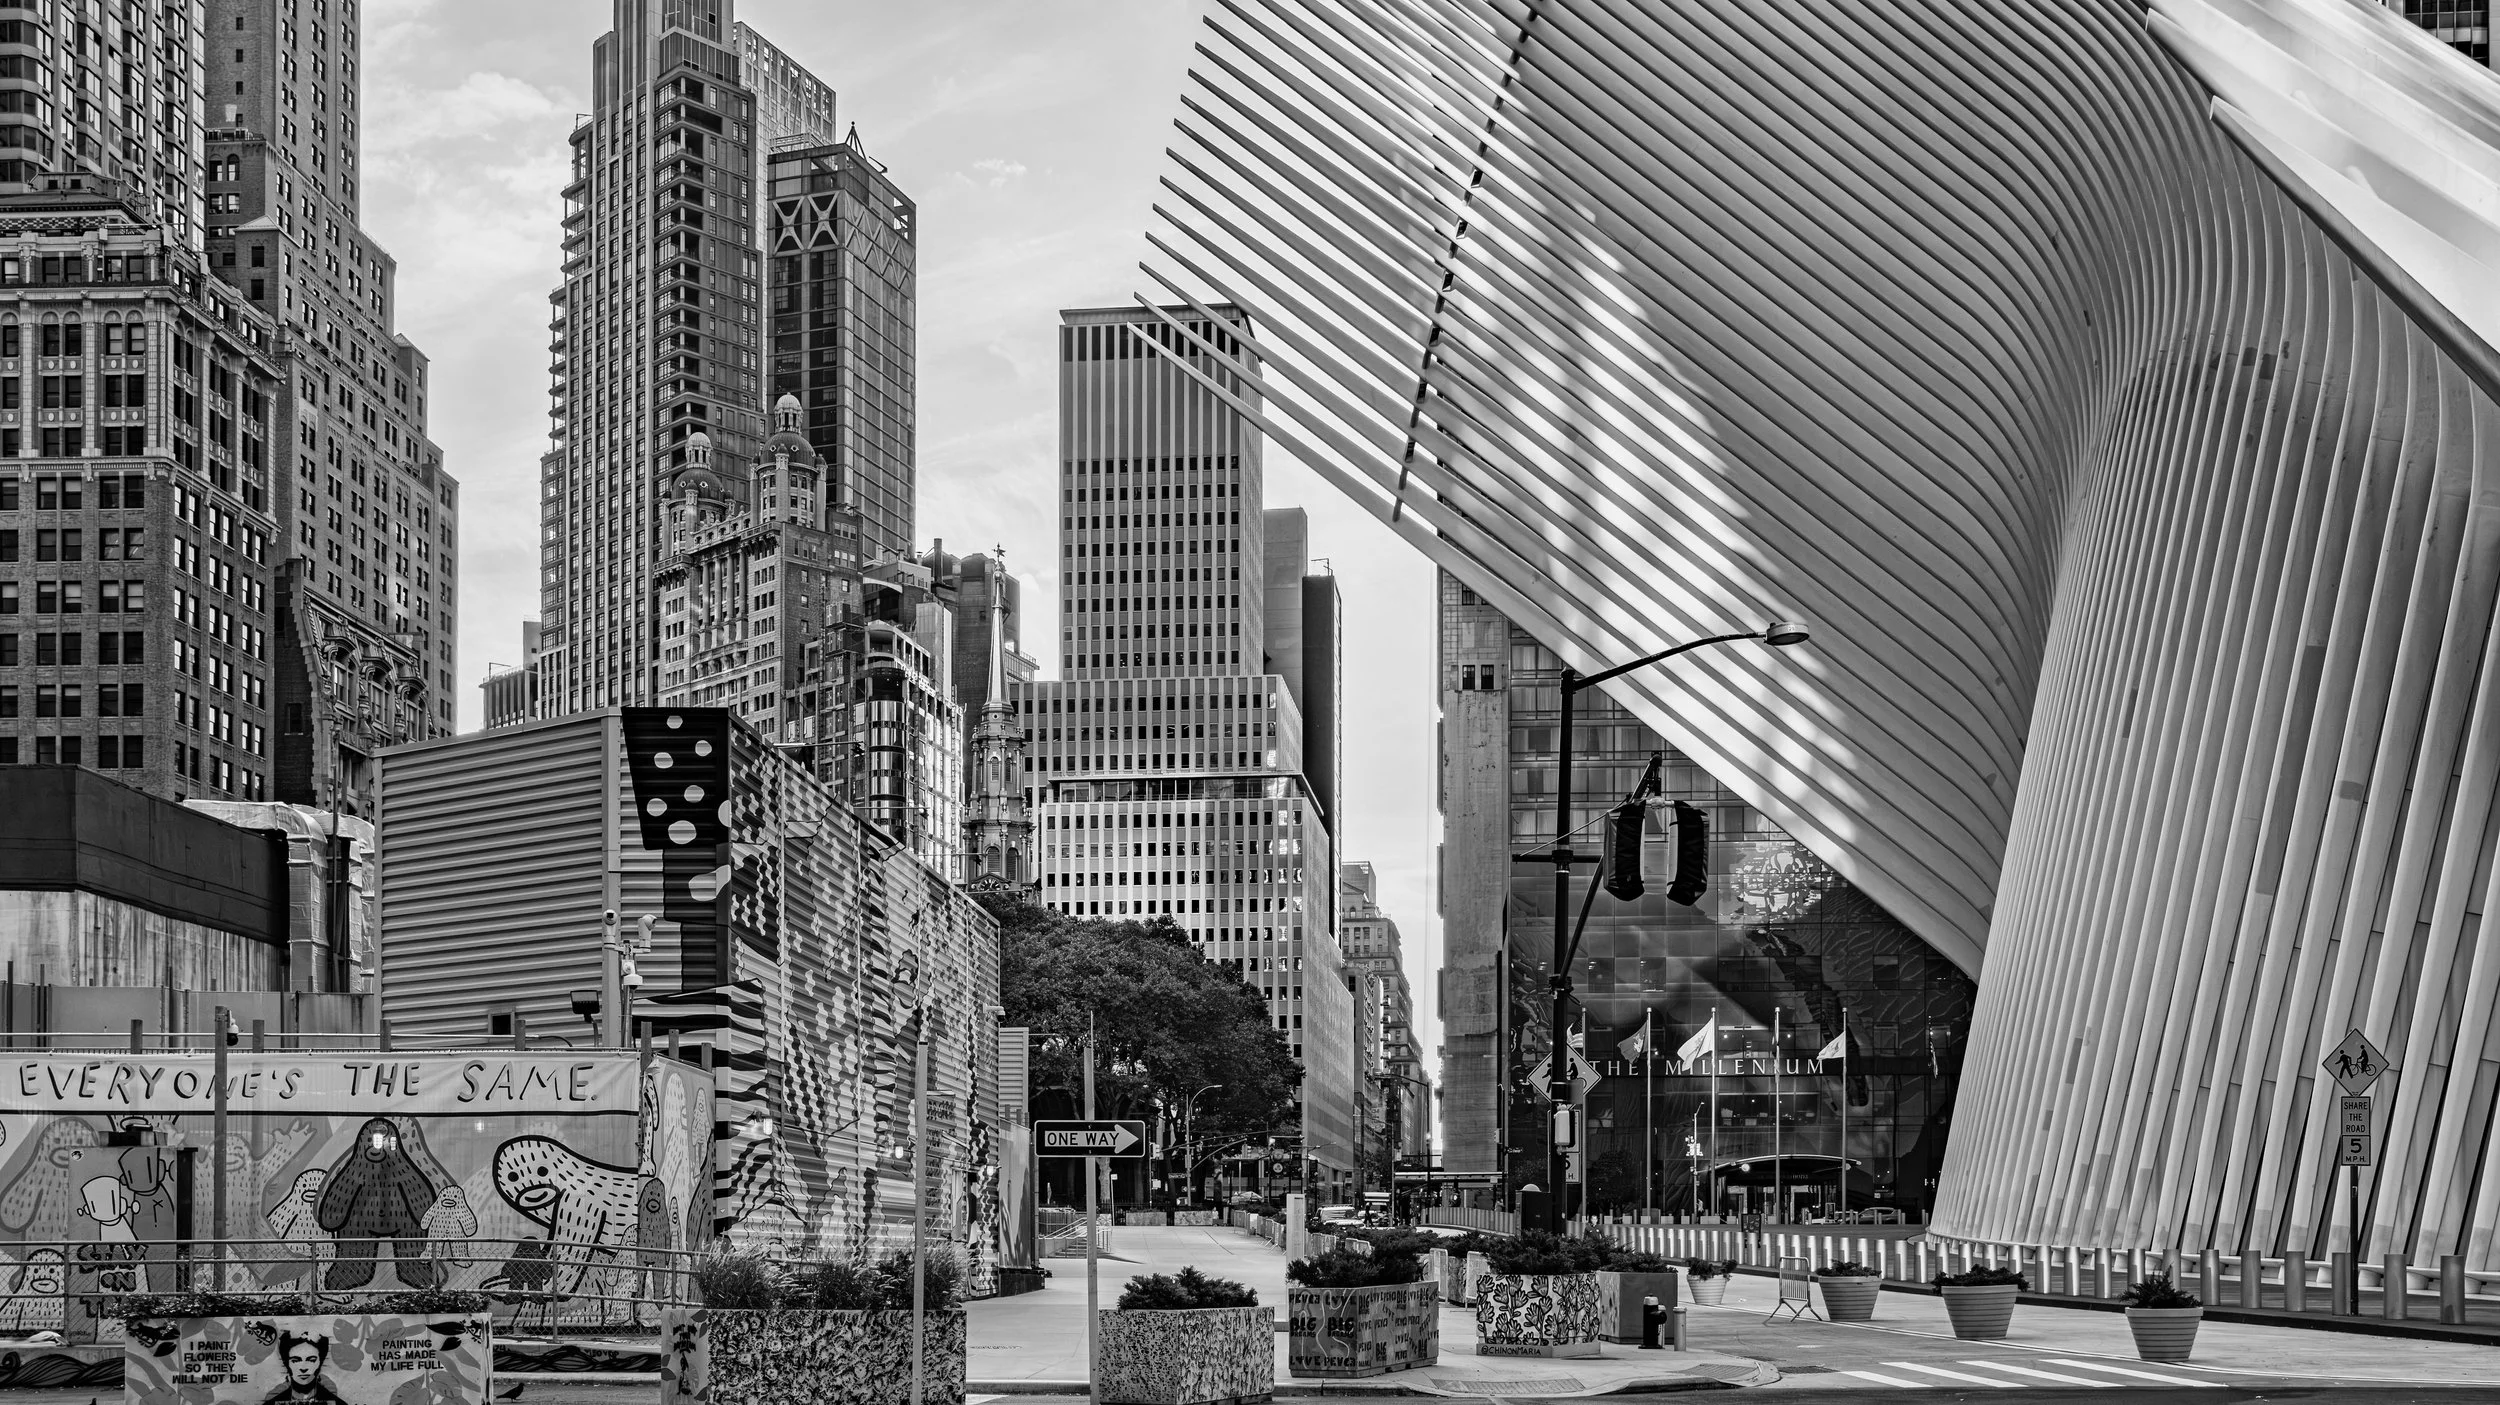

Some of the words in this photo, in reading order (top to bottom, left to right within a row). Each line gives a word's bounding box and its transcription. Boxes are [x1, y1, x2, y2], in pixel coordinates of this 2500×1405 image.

[1589, 1060, 1639, 1076] THE
[344, 1061, 421, 1097] THE
[457, 1059, 598, 1102] SAME.
[2343, 1101, 2368, 1110] SHARE
[2349, 1113, 2363, 1121] THE
[2345, 1124, 2366, 1133] ROAD
[1047, 1132, 1078, 1145] ONE
[1085, 1132, 1119, 1145] WAY
[2350, 1138, 2362, 1153] 5
[190, 1341, 194, 1350] I
[198, 1341, 231, 1350] PAINT
[382, 1339, 432, 1349] PAINTING
[184, 1352, 237, 1361] FLOWERS
[379, 1351, 401, 1360] HAS
[405, 1350, 436, 1359] MADE
[185, 1363, 201, 1373] SO
[206, 1363, 235, 1372] THEY
[371, 1362, 386, 1371] MY
[391, 1361, 414, 1371] LIFE
[418, 1361, 444, 1370] FULL
[172, 1374, 198, 1384] WILL
[202, 1374, 225, 1383] NOT
[230, 1374, 248, 1383] DIE
